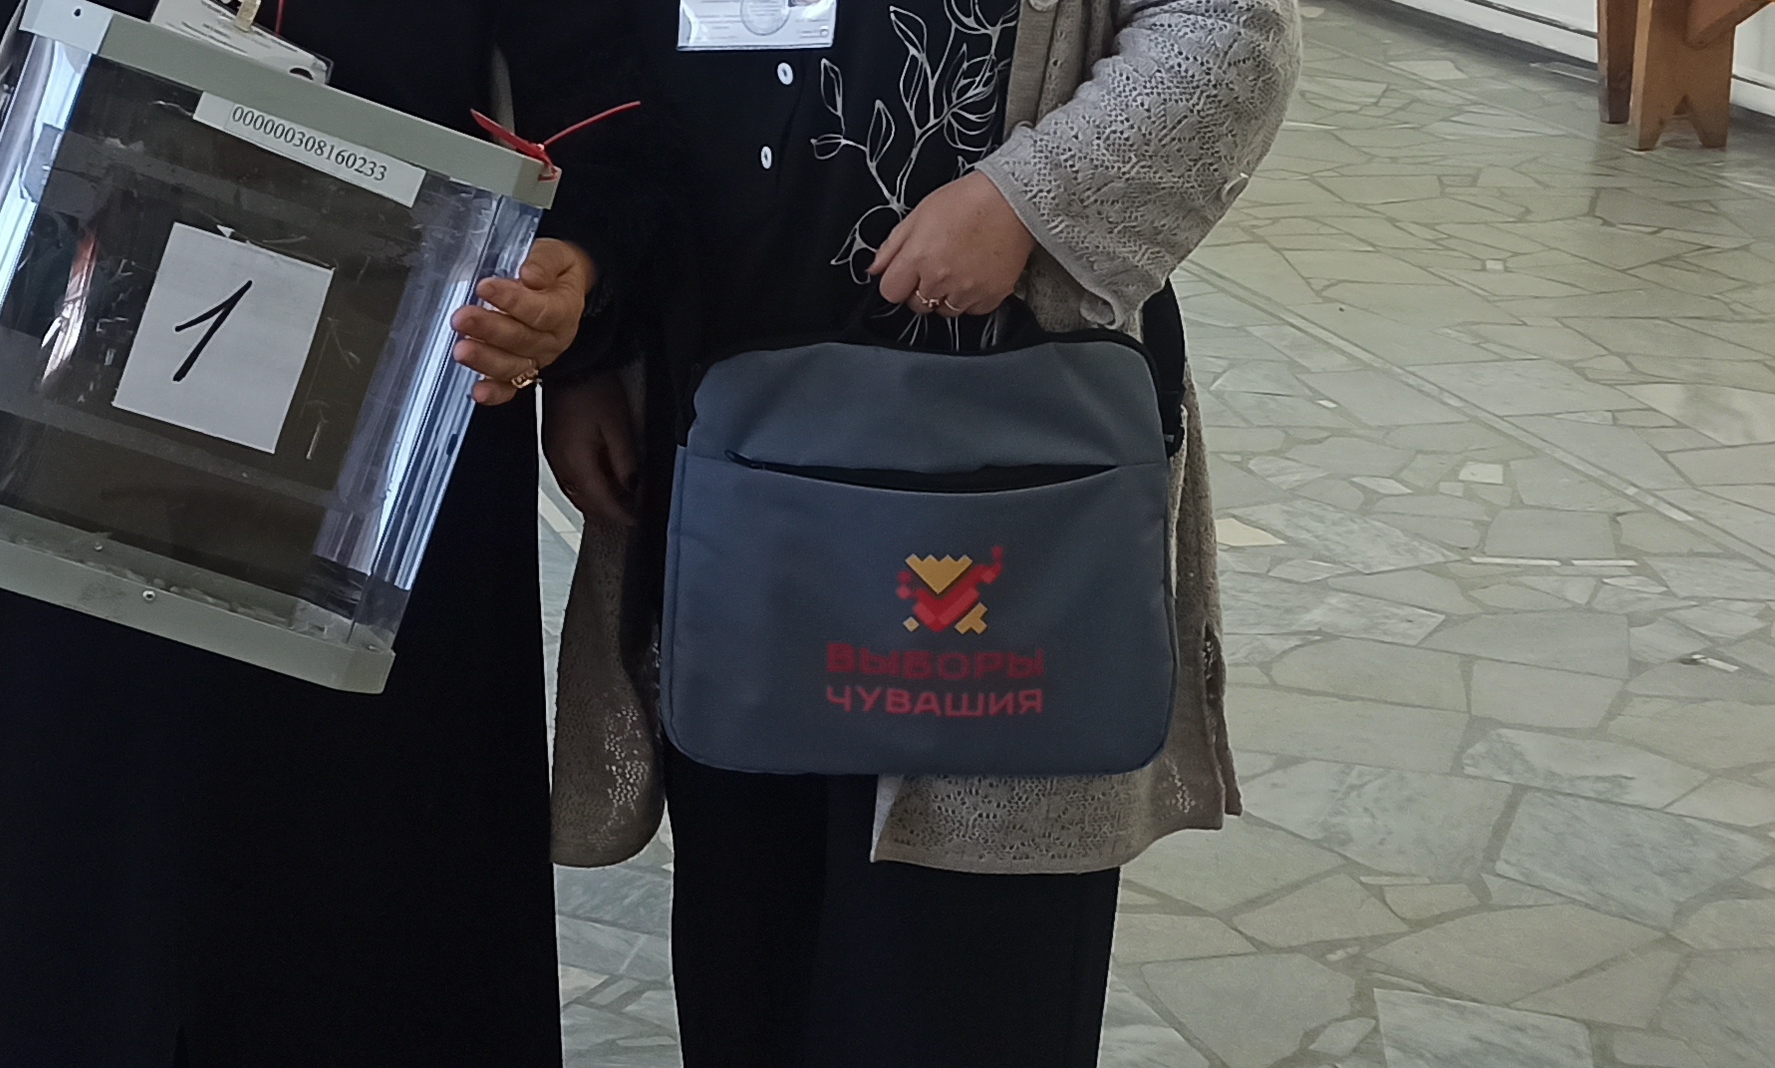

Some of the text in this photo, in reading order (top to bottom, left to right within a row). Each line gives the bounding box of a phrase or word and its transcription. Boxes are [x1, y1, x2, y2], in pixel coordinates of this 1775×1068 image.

[232, 106, 388, 181] 000000308160233
[173, 279, 253, 382] 1
[826, 642, 1044, 680] ВЫБОРЫ
[826, 685, 1044, 718] ЧУВАШИЯ
